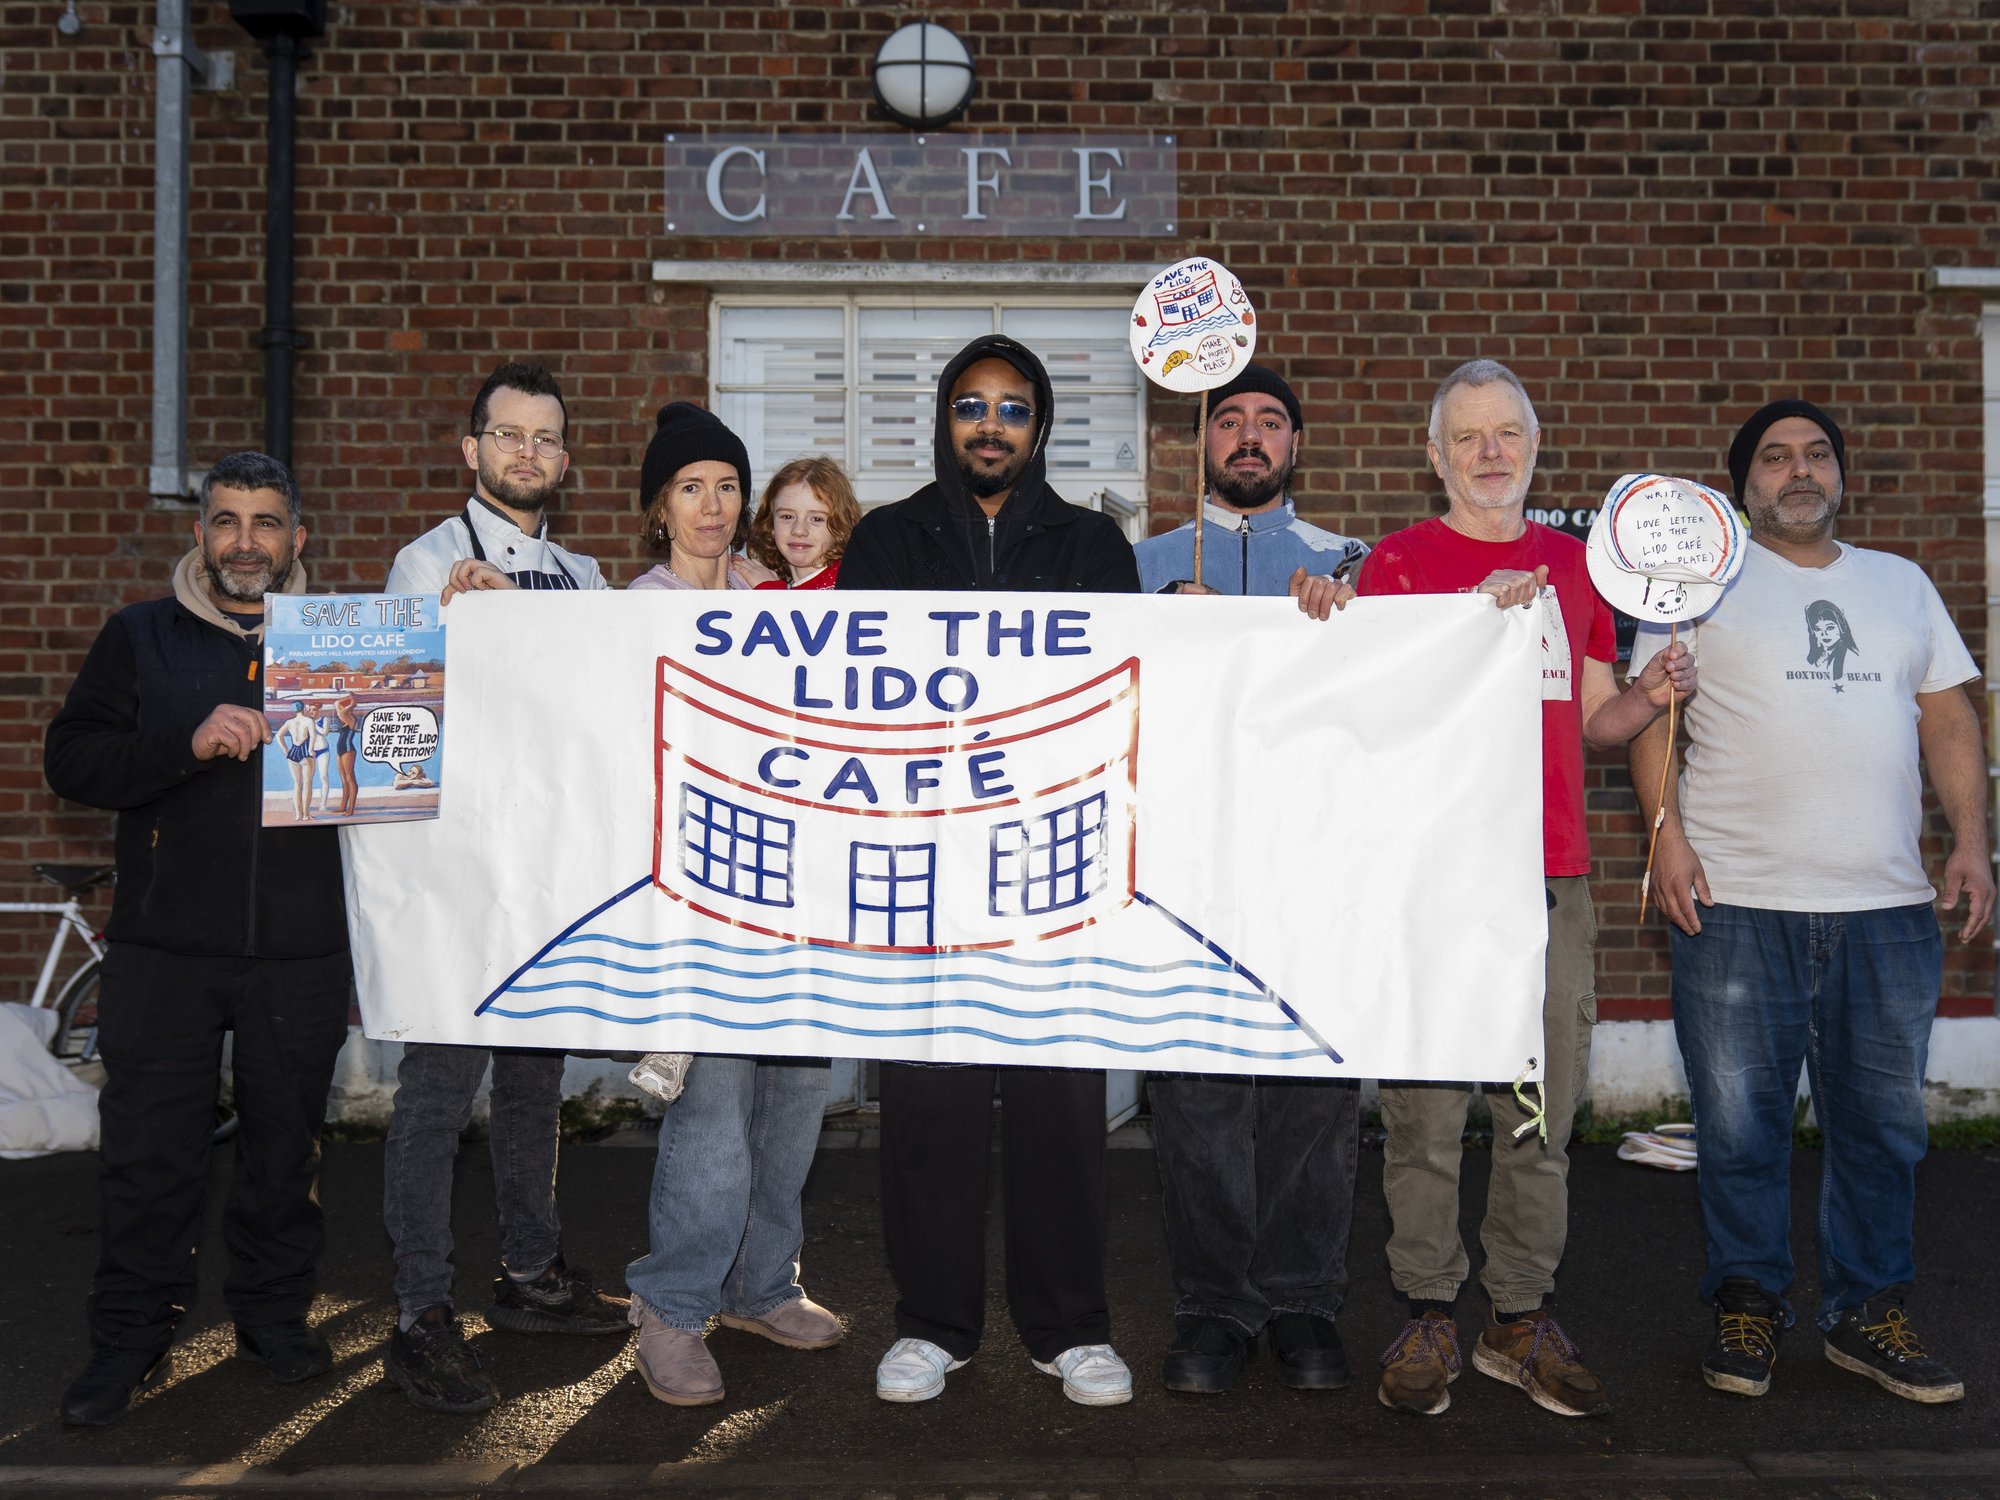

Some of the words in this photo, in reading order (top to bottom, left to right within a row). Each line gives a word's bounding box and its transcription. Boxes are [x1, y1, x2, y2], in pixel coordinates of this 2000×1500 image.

[705, 146, 1126, 222] CAFE
[1154, 267, 1184, 289] SAVE
[1186, 260, 1208, 272] THE
[1169, 275, 1191, 288] LIDO
[1201, 338, 1222, 351] MAKE
[1199, 354, 1207, 362] A
[1203, 357, 1227, 372] PLATE
[1645, 490, 1684, 501] WRITE
[1662, 504, 1670, 512] A
[1525, 508, 1566, 527] IDO
[1572, 509, 1598, 527] CA
[1636, 518, 1660, 530] LOVE
[1670, 516, 1705, 525] LETTER
[1650, 531, 1662, 539] TO
[1669, 527, 1688, 535] THE
[1642, 543, 1668, 556] LIDO
[1677, 535, 1702, 550] CAFÉ
[1638, 561, 1656, 569] (ON
[1677, 552, 1714, 565] PLATE)
[302, 602, 361, 627] SAVE
[375, 597, 423, 626] THE
[694, 610, 888, 657] SAVE
[928, 609, 1092, 657] THE
[311, 635, 355, 649] LIDO
[360, 634, 406, 648] CAFE
[376, 648, 398, 656] HEATH
[398, 648, 426, 656] LONDON
[1541, 669, 1566, 679] EACH
[1785, 670, 1831, 681] HOXTON
[1846, 672, 1882, 682] BEACH
[793, 665, 979, 713] LIDO
[372, 711, 394, 722] HAVE
[396, 711, 411, 721] YOU
[370, 723, 401, 734] SIGNED
[402, 724, 420, 735] THE
[368, 735, 394, 746] SAVE
[397, 734, 416, 745] THE
[418, 733, 438, 745] LIDO
[363, 745, 390, 758] CAFÉ
[391, 745, 436, 758] PETITION?
[757, 730, 1014, 804] CAFÉ
